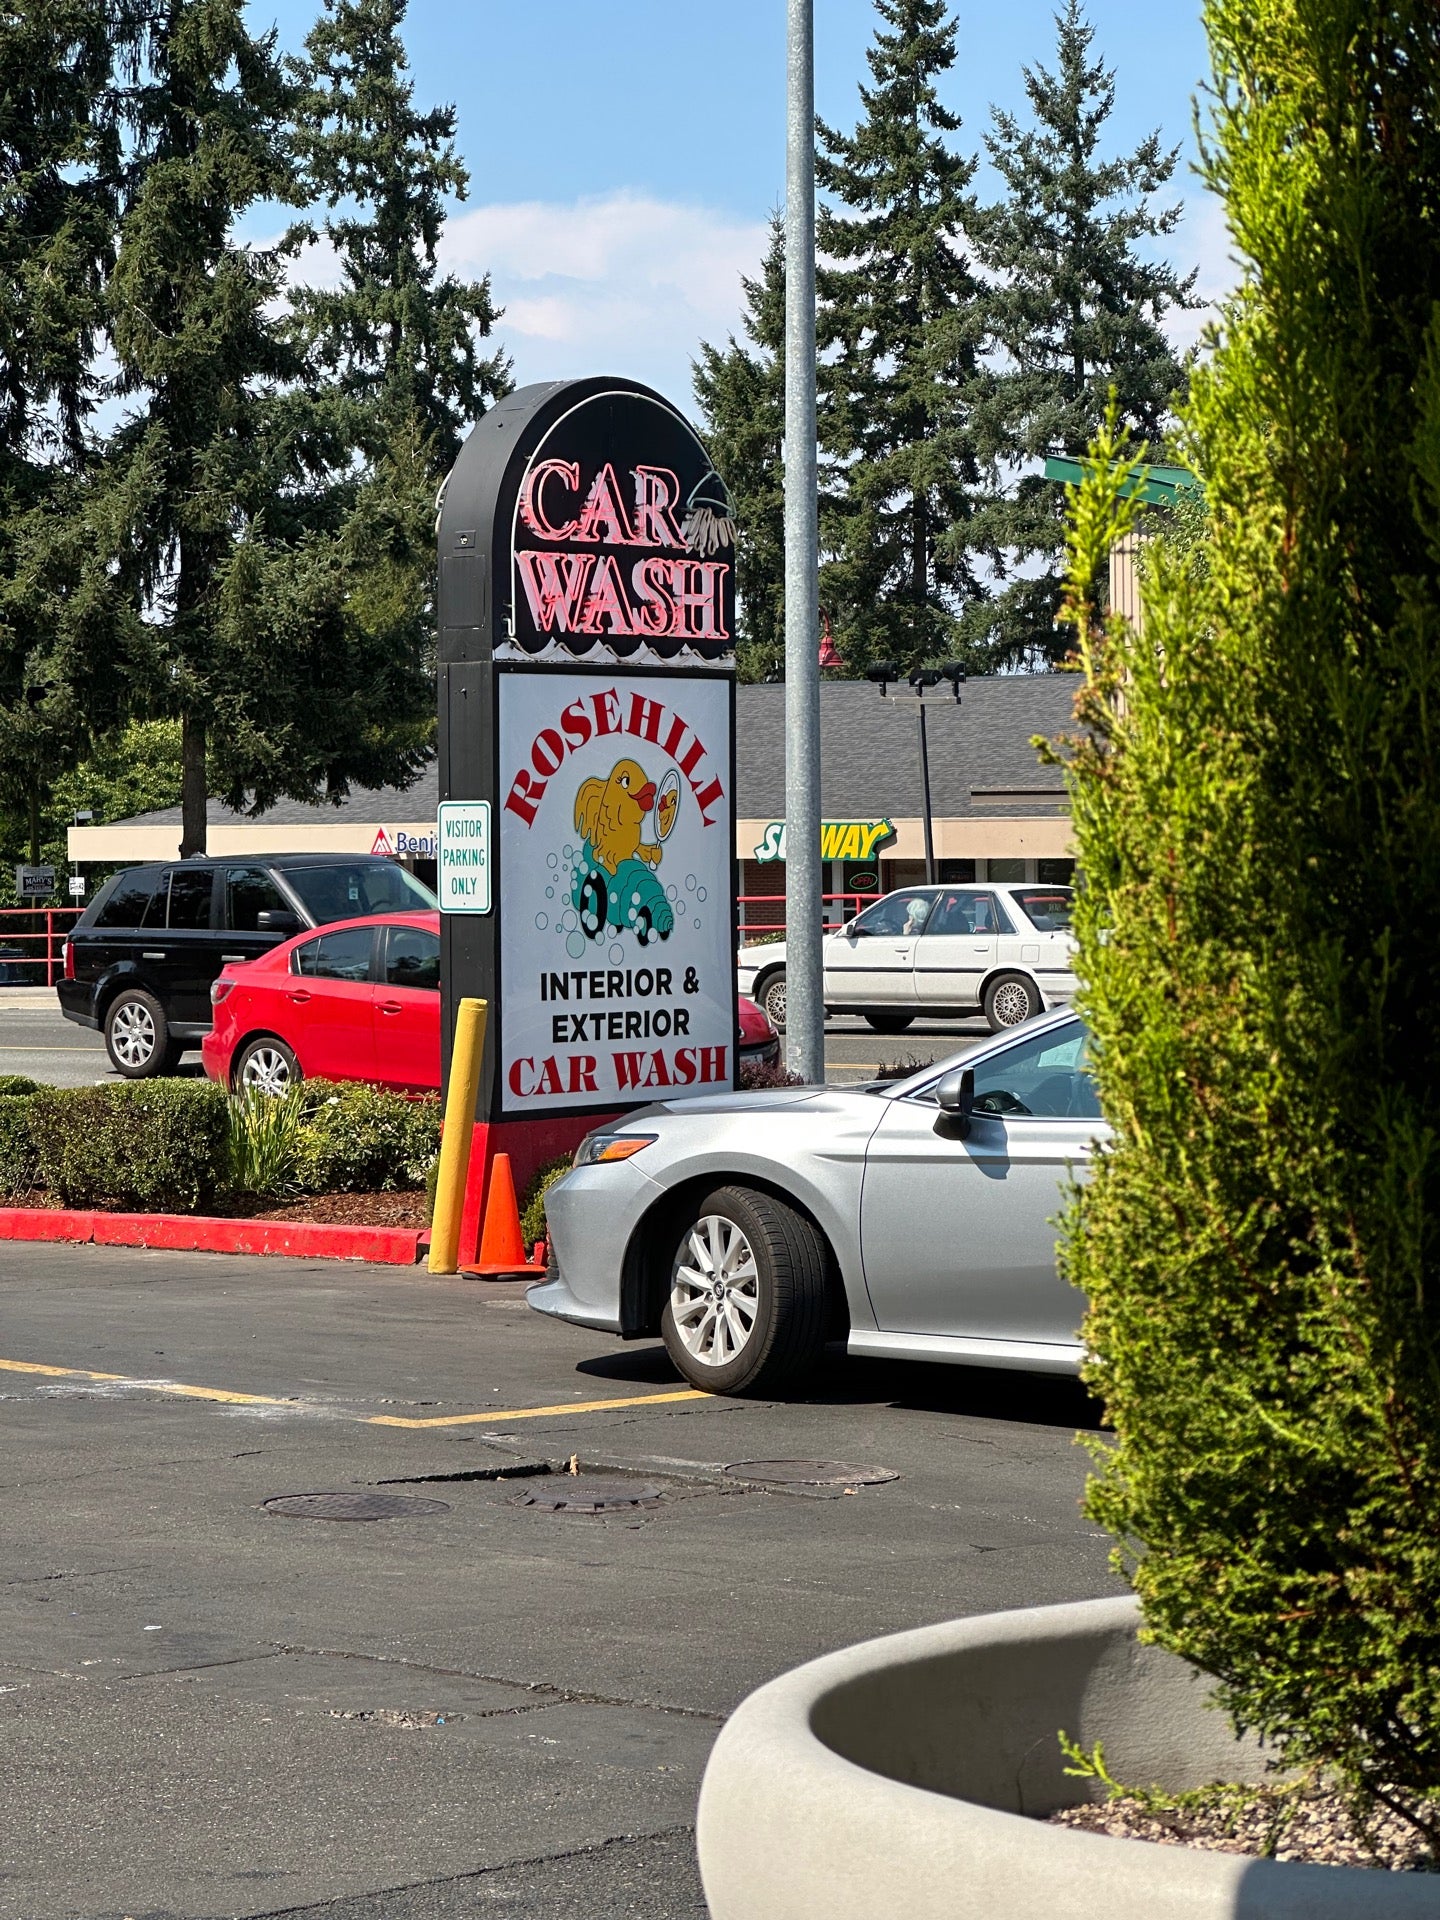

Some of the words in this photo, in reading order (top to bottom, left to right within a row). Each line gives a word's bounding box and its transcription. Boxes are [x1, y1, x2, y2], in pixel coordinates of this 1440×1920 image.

[519, 458, 690, 549] CAR
[514, 550, 730, 640] WASH
[504, 687, 725, 830] ROSEHILL
[445, 820, 482, 838] VISITOR
[755, 821, 890, 860] SWAY
[443, 849, 485, 866] PARKING
[451, 877, 477, 895] ONLY
[853, 876, 873, 886] OPEN
[541, 968, 673, 1001] INTERIOR
[683, 966, 700, 994] &
[552, 1008, 690, 1043] EXTERIOR
[508, 1055, 600, 1097] CAR
[611, 1045, 729, 1092] WASH
